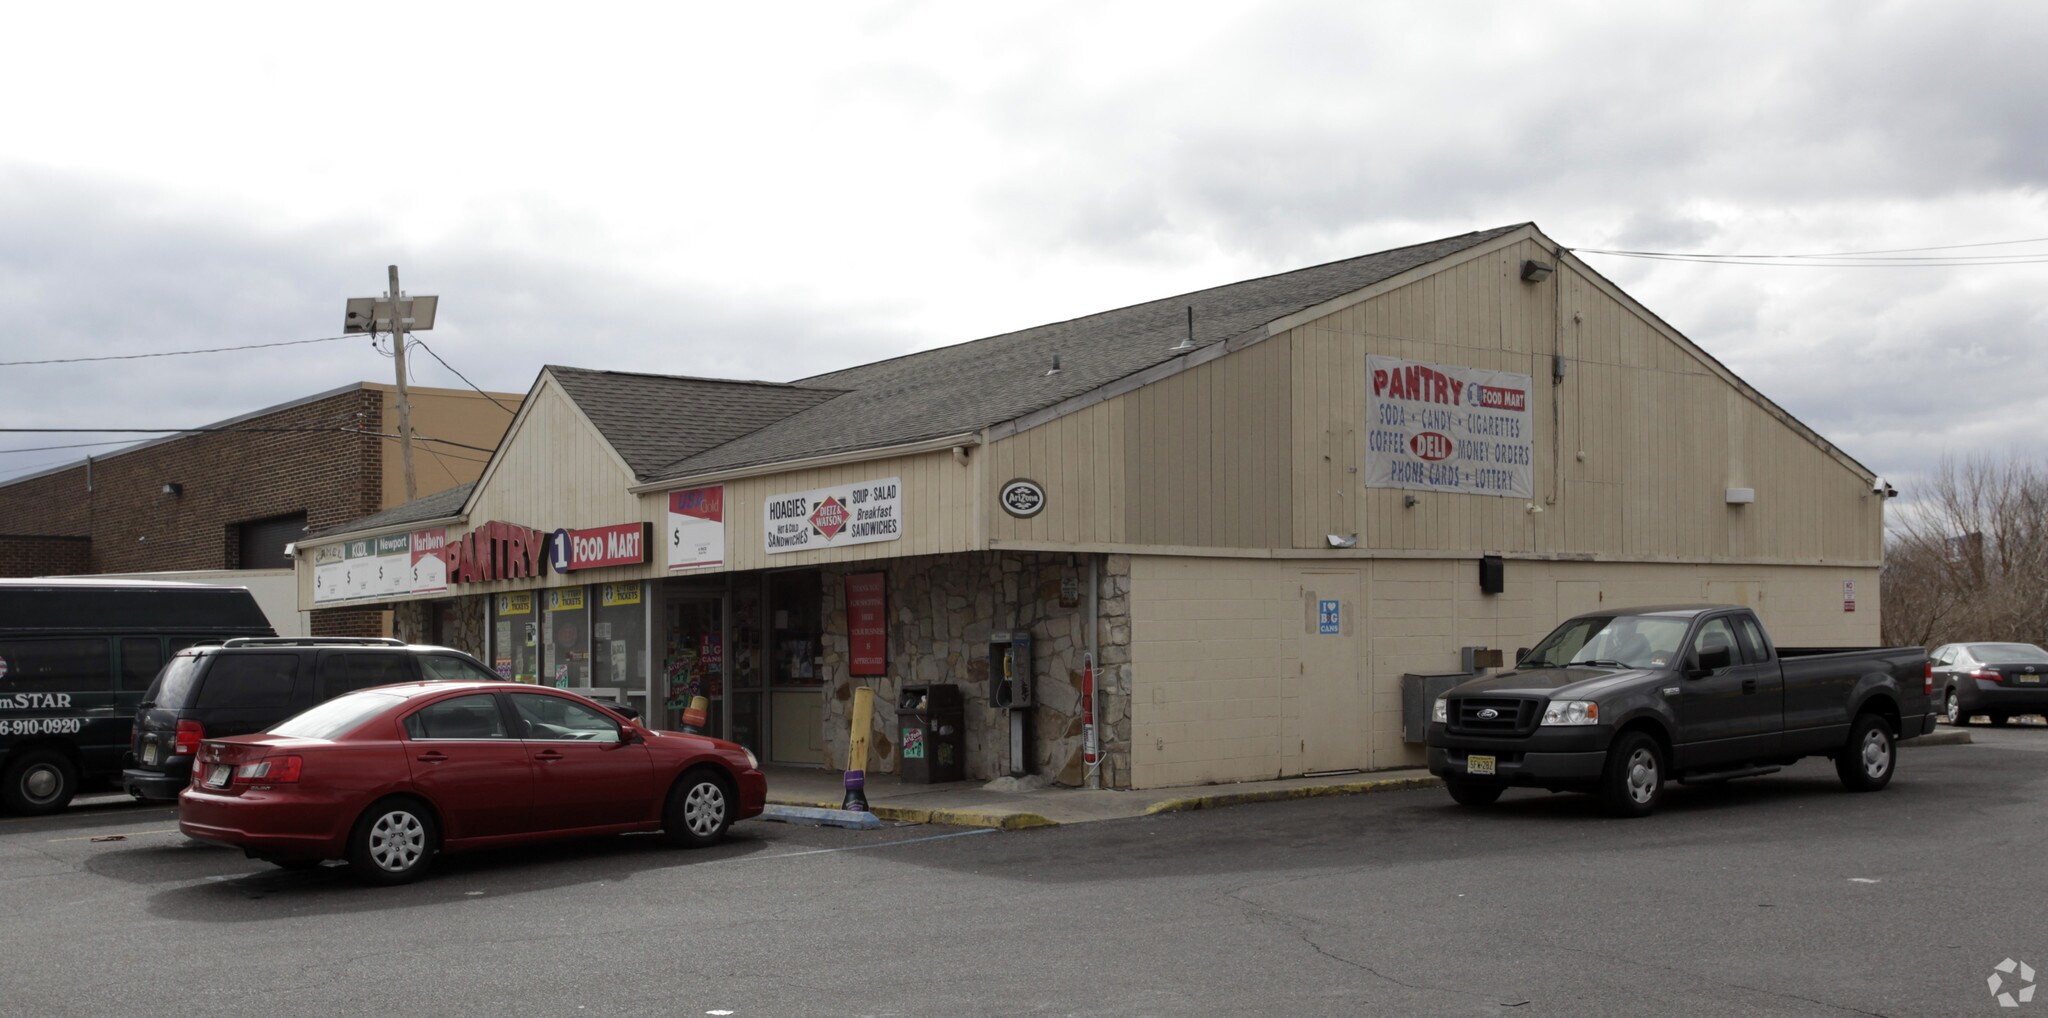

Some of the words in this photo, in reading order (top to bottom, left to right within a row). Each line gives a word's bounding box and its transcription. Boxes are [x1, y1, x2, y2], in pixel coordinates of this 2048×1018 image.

[1373, 365, 1463, 406] PANTRY
[1469, 384, 1480, 405] 1
[1482, 388, 1502, 405] FOOD
[1504, 390, 1525, 408] MART
[1379, 403, 1406, 427] SODA
[1421, 408, 1453, 431] CANDY
[1467, 413, 1520, 438] CIGARETTES
[1369, 430, 1405, 454] COFFEE
[1416, 434, 1446, 458] DELI
[1457, 440, 1490, 462] MONEY
[1494, 443, 1529, 466] ORDERS
[1391, 460, 1424, 484] PHONE
[1428, 464, 1460, 487] CARDS
[1475, 468, 1514, 491] LOTTERY
[852, 488, 869, 504] SOUP
[873, 485, 897, 502] SALAD
[700, 498, 719, 514] Gold
[769, 498, 807, 520] HOAGIES
[820, 505, 836, 517] DIETZ
[857, 505, 892, 521] Breakfast
[777, 525, 785, 535] HOT
[791, 523, 799, 533] COLD
[815, 514, 843, 527] WATSON
[851, 519, 898, 538] SANDWICHES
[380, 536, 407, 552] Newport
[413, 532, 444, 552] Marlboro
[768, 528, 808, 549] SANDWICHES
[315, 546, 343, 563] CAMEL
[352, 541, 368, 558] KOOL
[446, 520, 546, 584] PANTRY
[554, 533, 568, 569] 1
[573, 535, 603, 563] FOOD
[607, 531, 640, 560] MART
[617, 591, 638, 601] TICKETS
[1320, 625, 1338, 633] CANS
[854, 657, 883, 665] APPRECIATED
[1480, 710, 1496, 718] Ford
